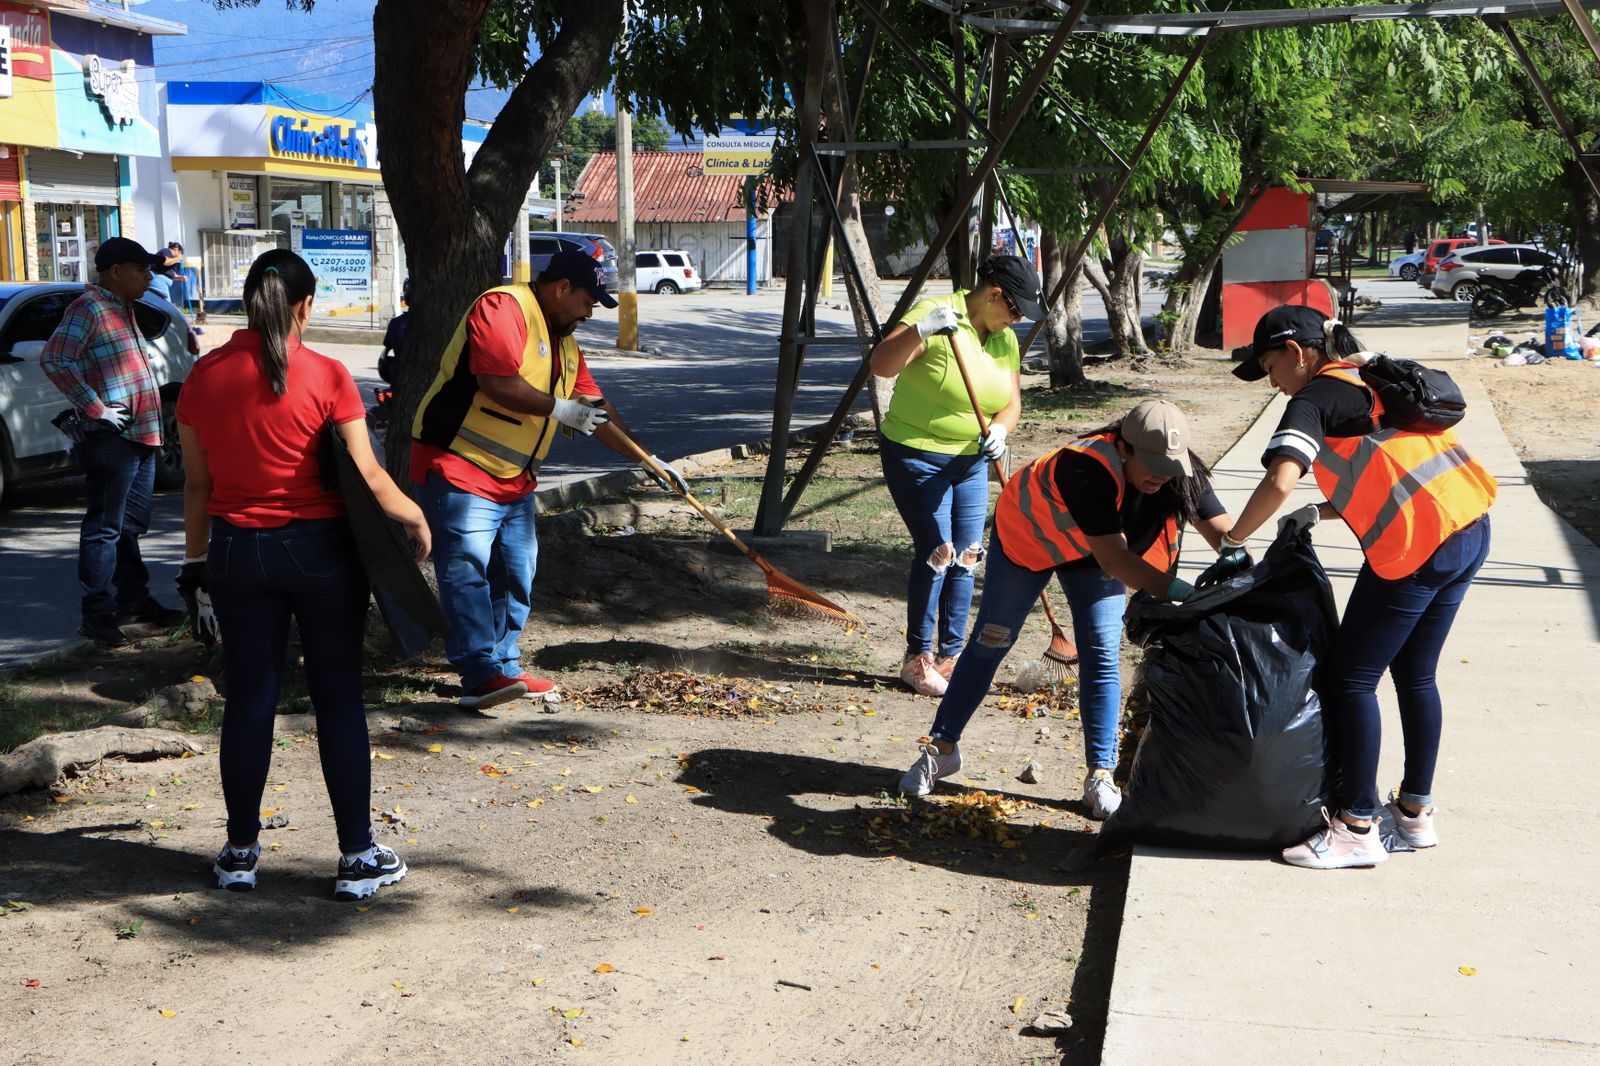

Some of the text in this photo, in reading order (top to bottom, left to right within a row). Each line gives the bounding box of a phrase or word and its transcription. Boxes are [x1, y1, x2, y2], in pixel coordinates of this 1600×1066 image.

[705, 158, 739, 168] Clínica
[742, 158, 750, 168] &
[320, 258, 366, 266] 2207-1000
[1167, 428, 1181, 450] C
